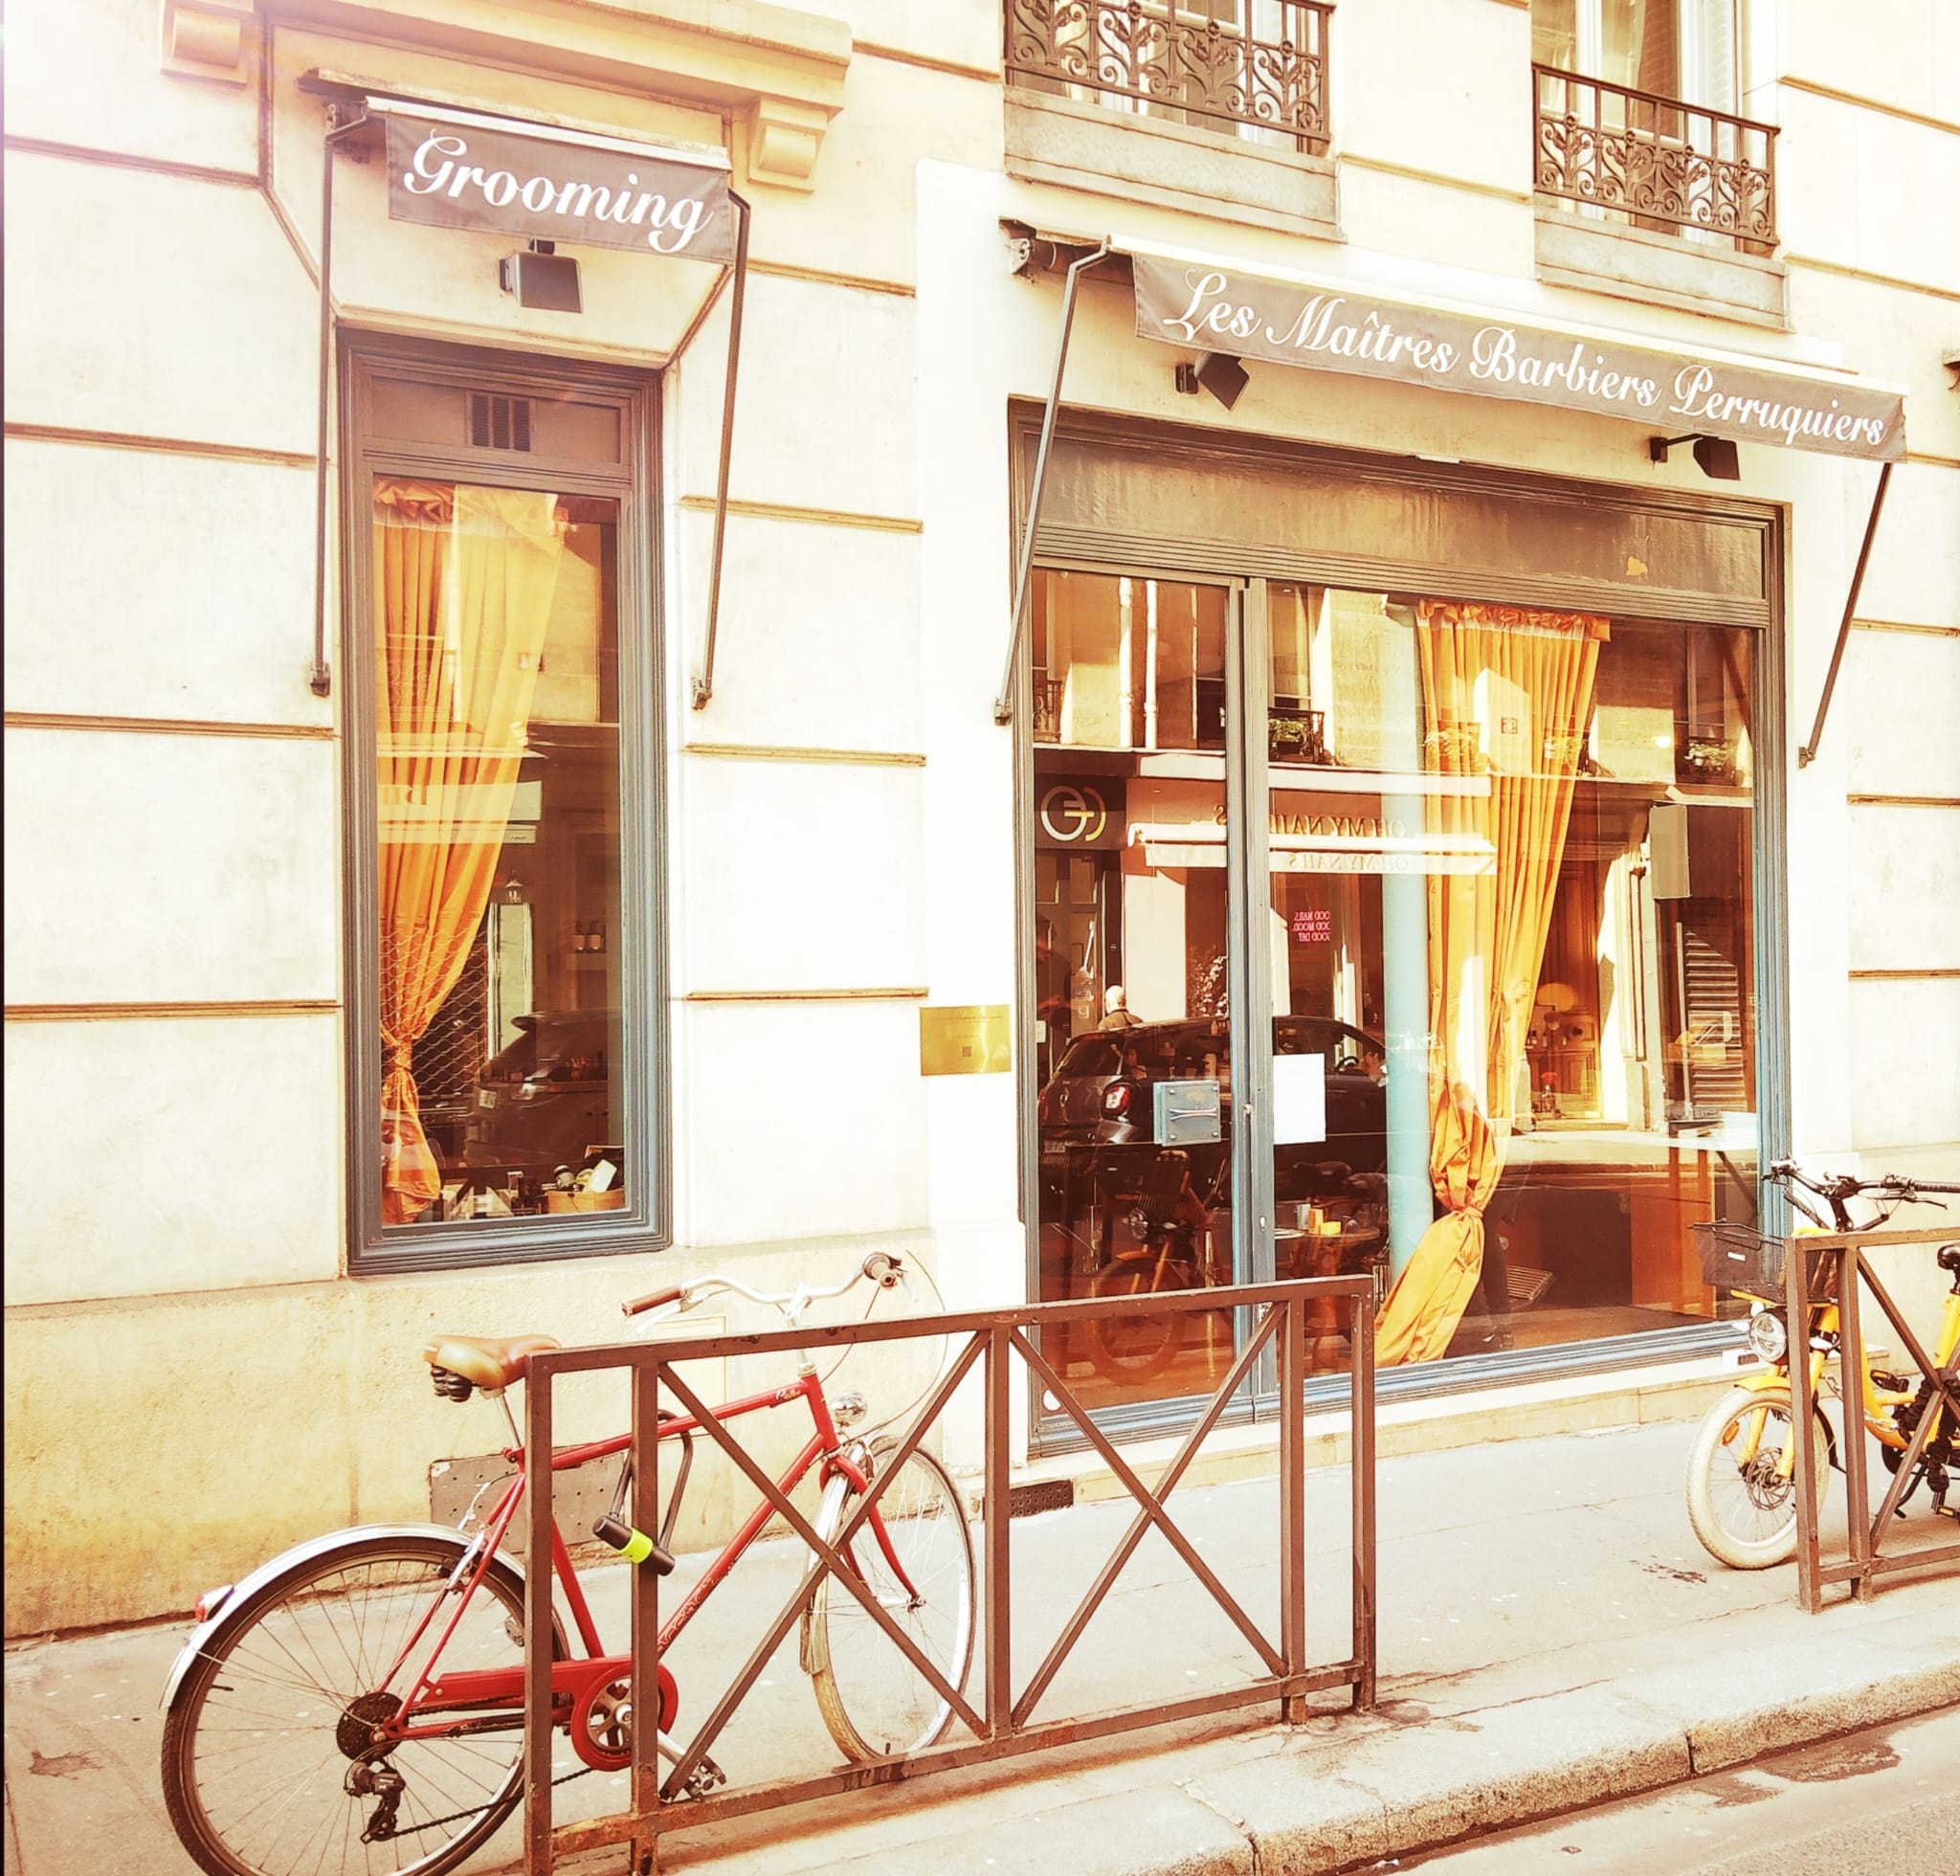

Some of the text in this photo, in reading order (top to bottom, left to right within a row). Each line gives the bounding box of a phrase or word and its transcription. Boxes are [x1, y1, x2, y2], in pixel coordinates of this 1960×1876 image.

[403, 128, 714, 254] Grooming
[1163, 269, 1887, 445] Les Maîtres Barbiers Perruquiers
